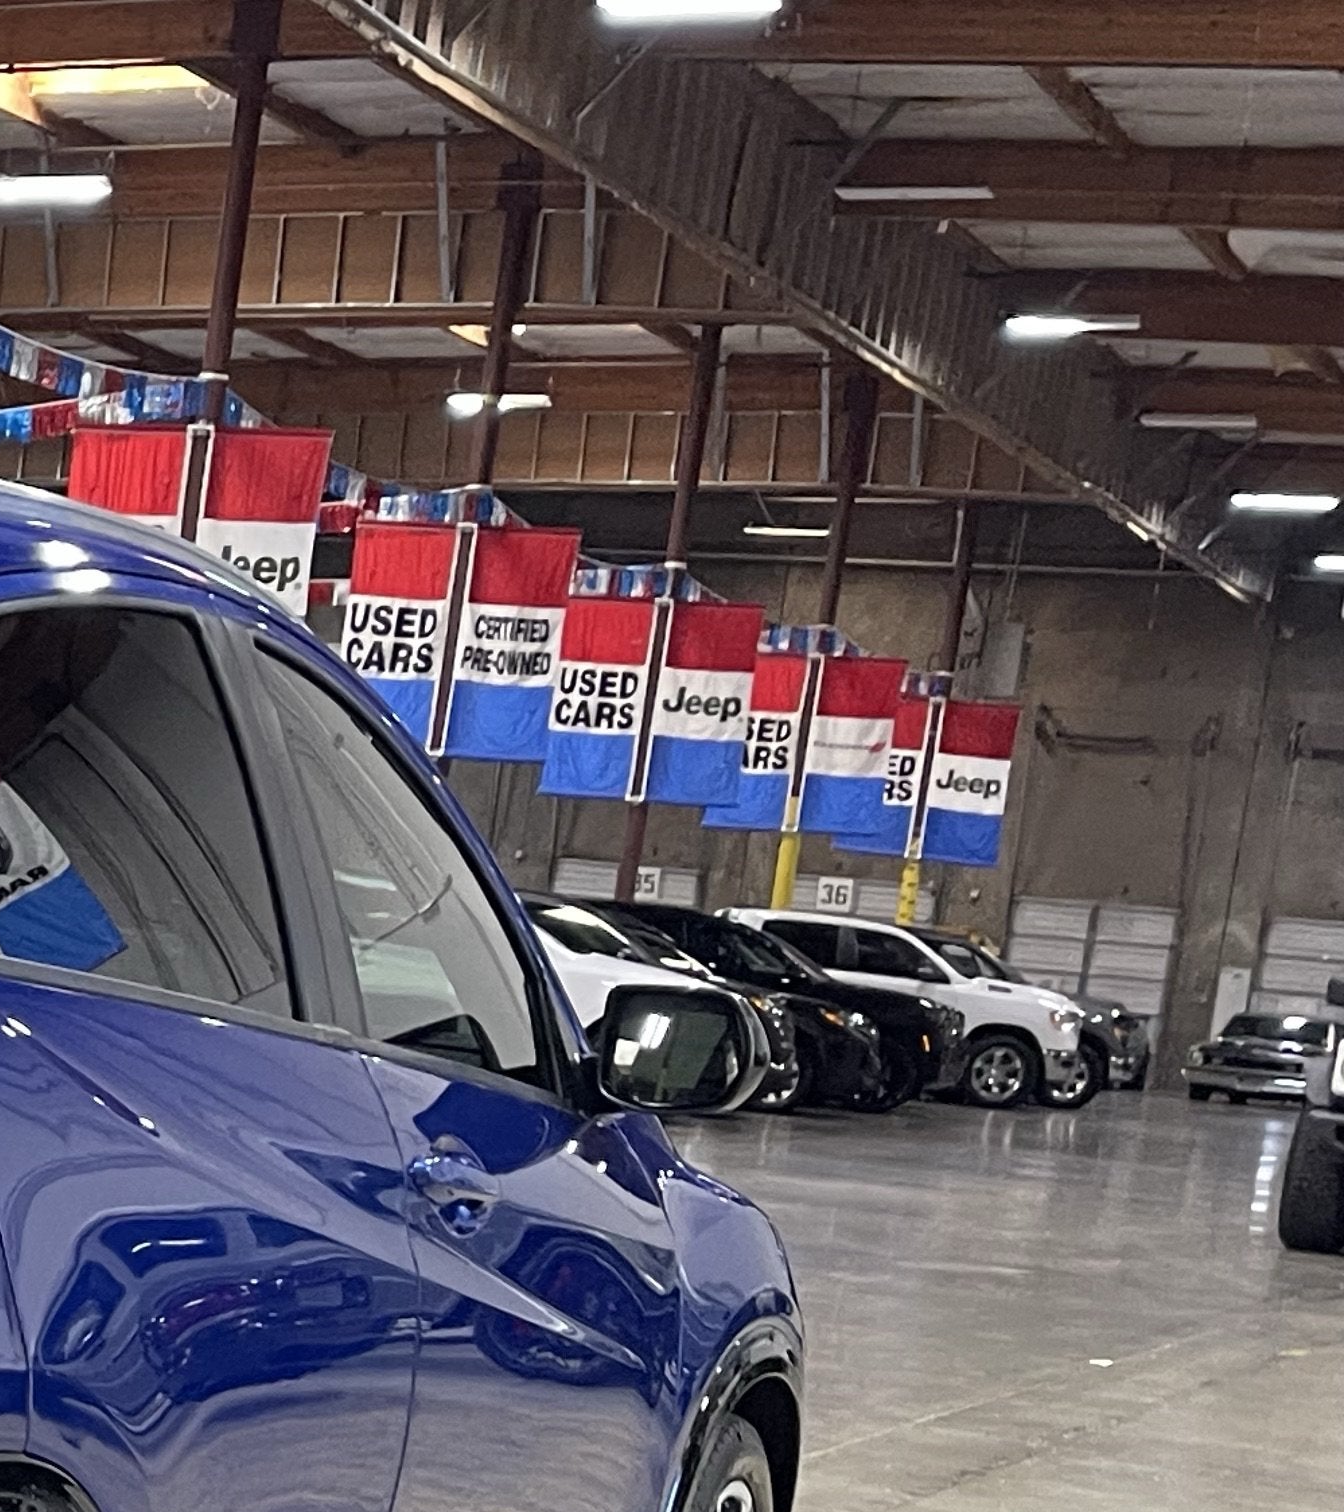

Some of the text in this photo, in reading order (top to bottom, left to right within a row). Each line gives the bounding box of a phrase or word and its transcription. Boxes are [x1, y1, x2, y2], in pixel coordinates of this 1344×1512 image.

[350, 603, 438, 639] USED
[474, 614, 550, 643] CERTIFIED
[347, 637, 435, 674] CARS
[461, 646, 552, 677] PRE-OWNED
[560, 667, 639, 700] USED
[554, 698, 636, 729] CARS
[662, 686, 742, 723] Jeep
[936, 769, 1002, 799] Jeep
[820, 883, 849, 906] 36
